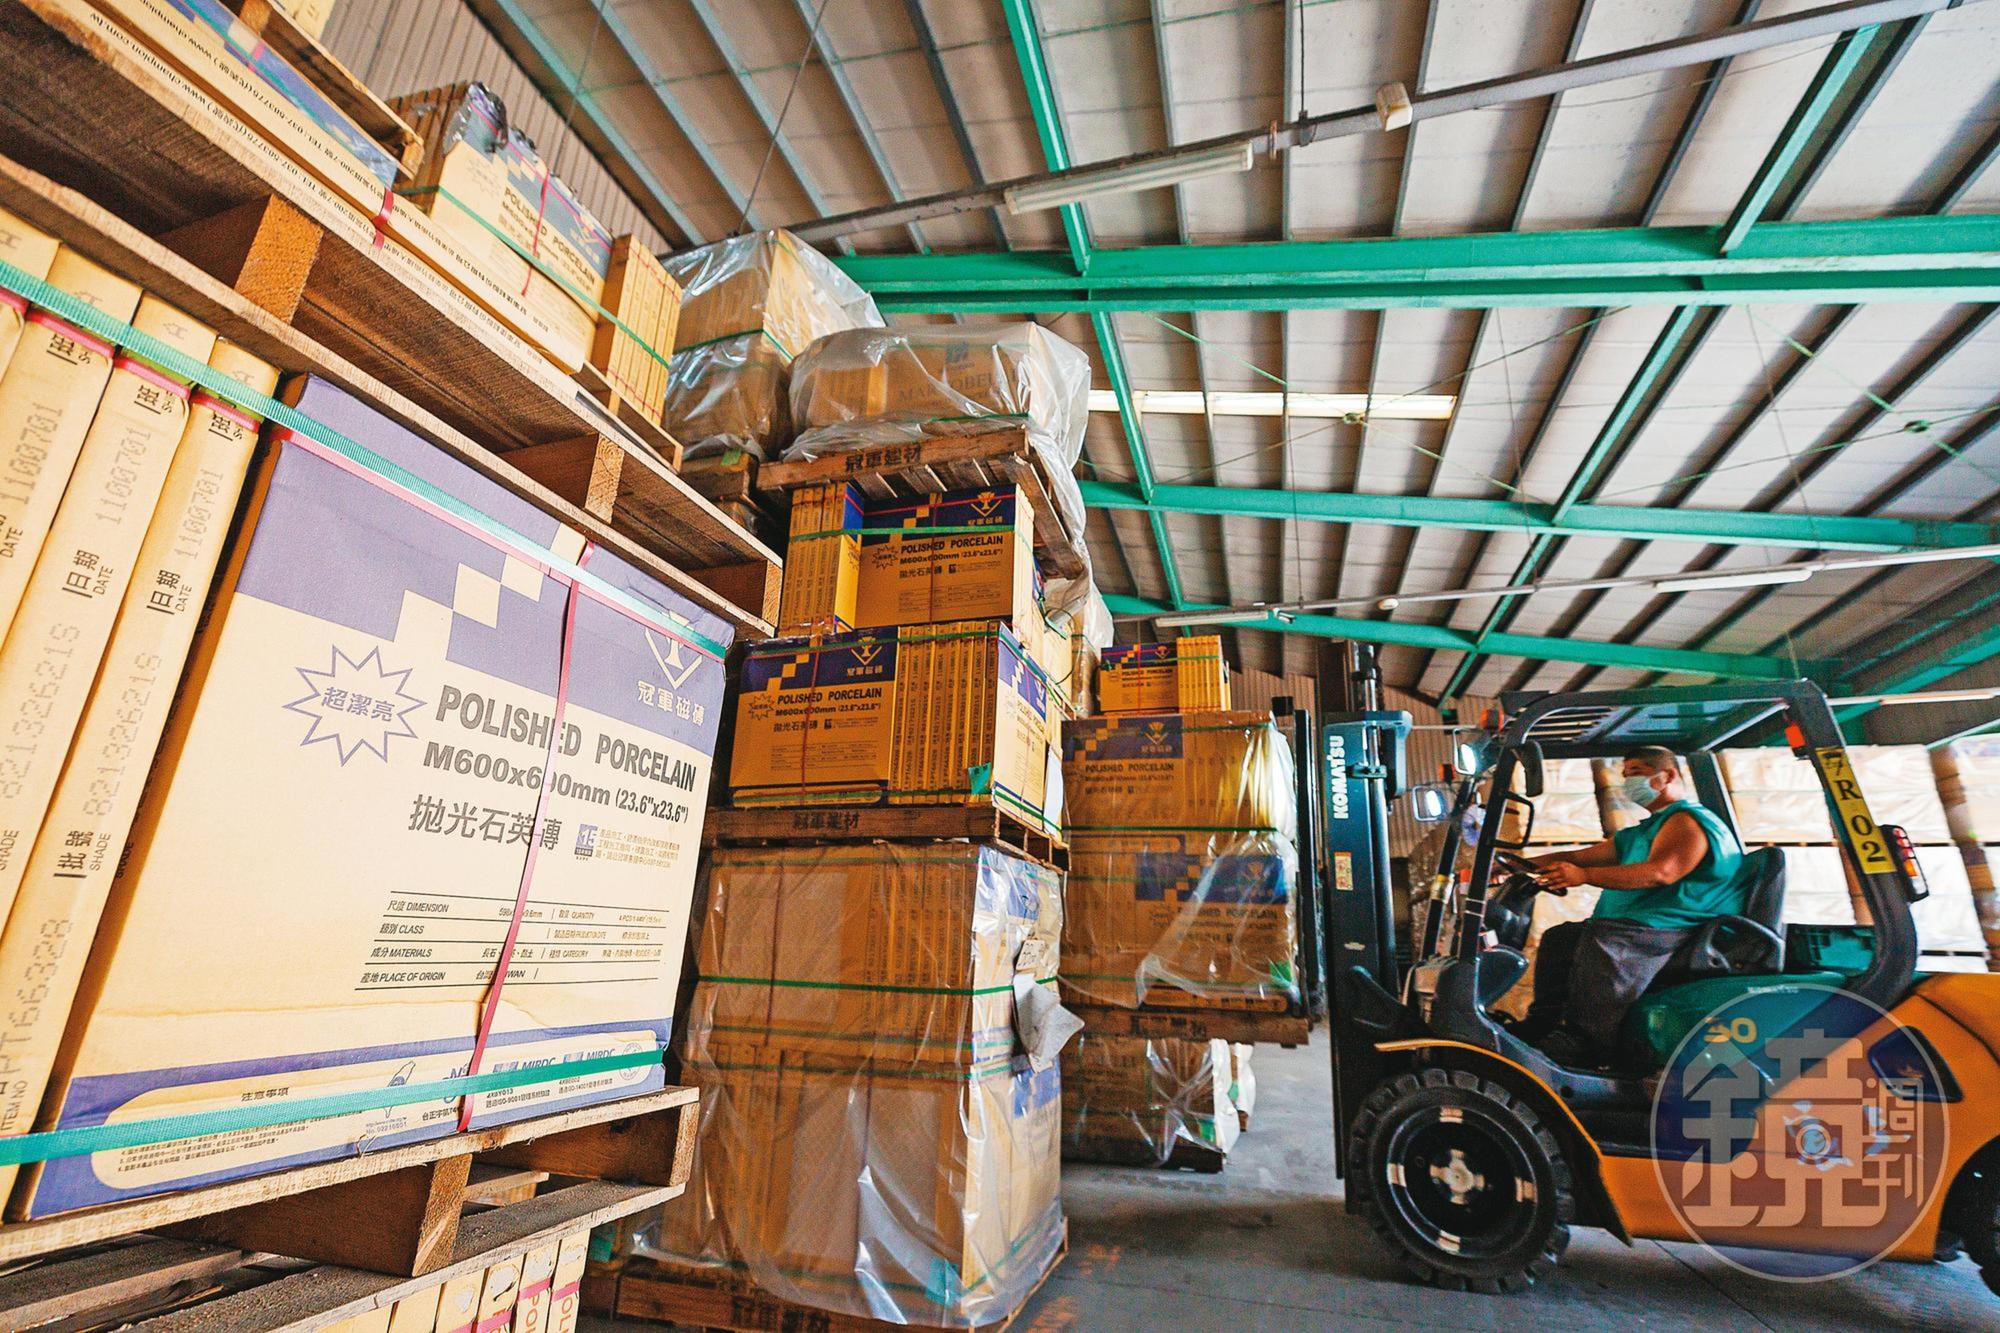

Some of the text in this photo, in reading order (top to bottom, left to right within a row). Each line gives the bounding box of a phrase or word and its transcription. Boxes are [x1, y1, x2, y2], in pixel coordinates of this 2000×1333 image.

[552, 236, 596, 285] PORCELAIN
[97, 425, 153, 526] 1100701
[175, 469, 225, 560] 1100701
[1, 527, 24, 558] DATE
[901, 536, 1003, 554] POLISHED PORCELAIN
[66, 549, 101, 590] 日期
[93, 567, 115, 596] DATE
[150, 569, 181, 607] 日期
[175, 584, 193, 613] DATE
[320, 686, 397, 724] 超潔亮
[777, 688, 883, 705] POLISHED PORCELAIN
[423, 741, 611, 806] M600x60mm
[595, 733, 698, 793] PORCELAIN
[1085, 762, 1174, 773] POLISHED PORCELAIN
[1329, 735, 1349, 819] KOMATSU
[57, 830, 94, 870] 批號
[89, 832, 112, 872] SHADE
[388, 900, 449, 913] 尺度 DIMENSION
[398, 924, 425, 935] CLASS
[370, 948, 433, 958] 成分 MATERIALS
[379, 973, 405, 983] PLACE
[406, 973, 418, 981] OF
[418, 972, 446, 981] ORIGIN
[241, 1086, 290, 1102] 注意事項
